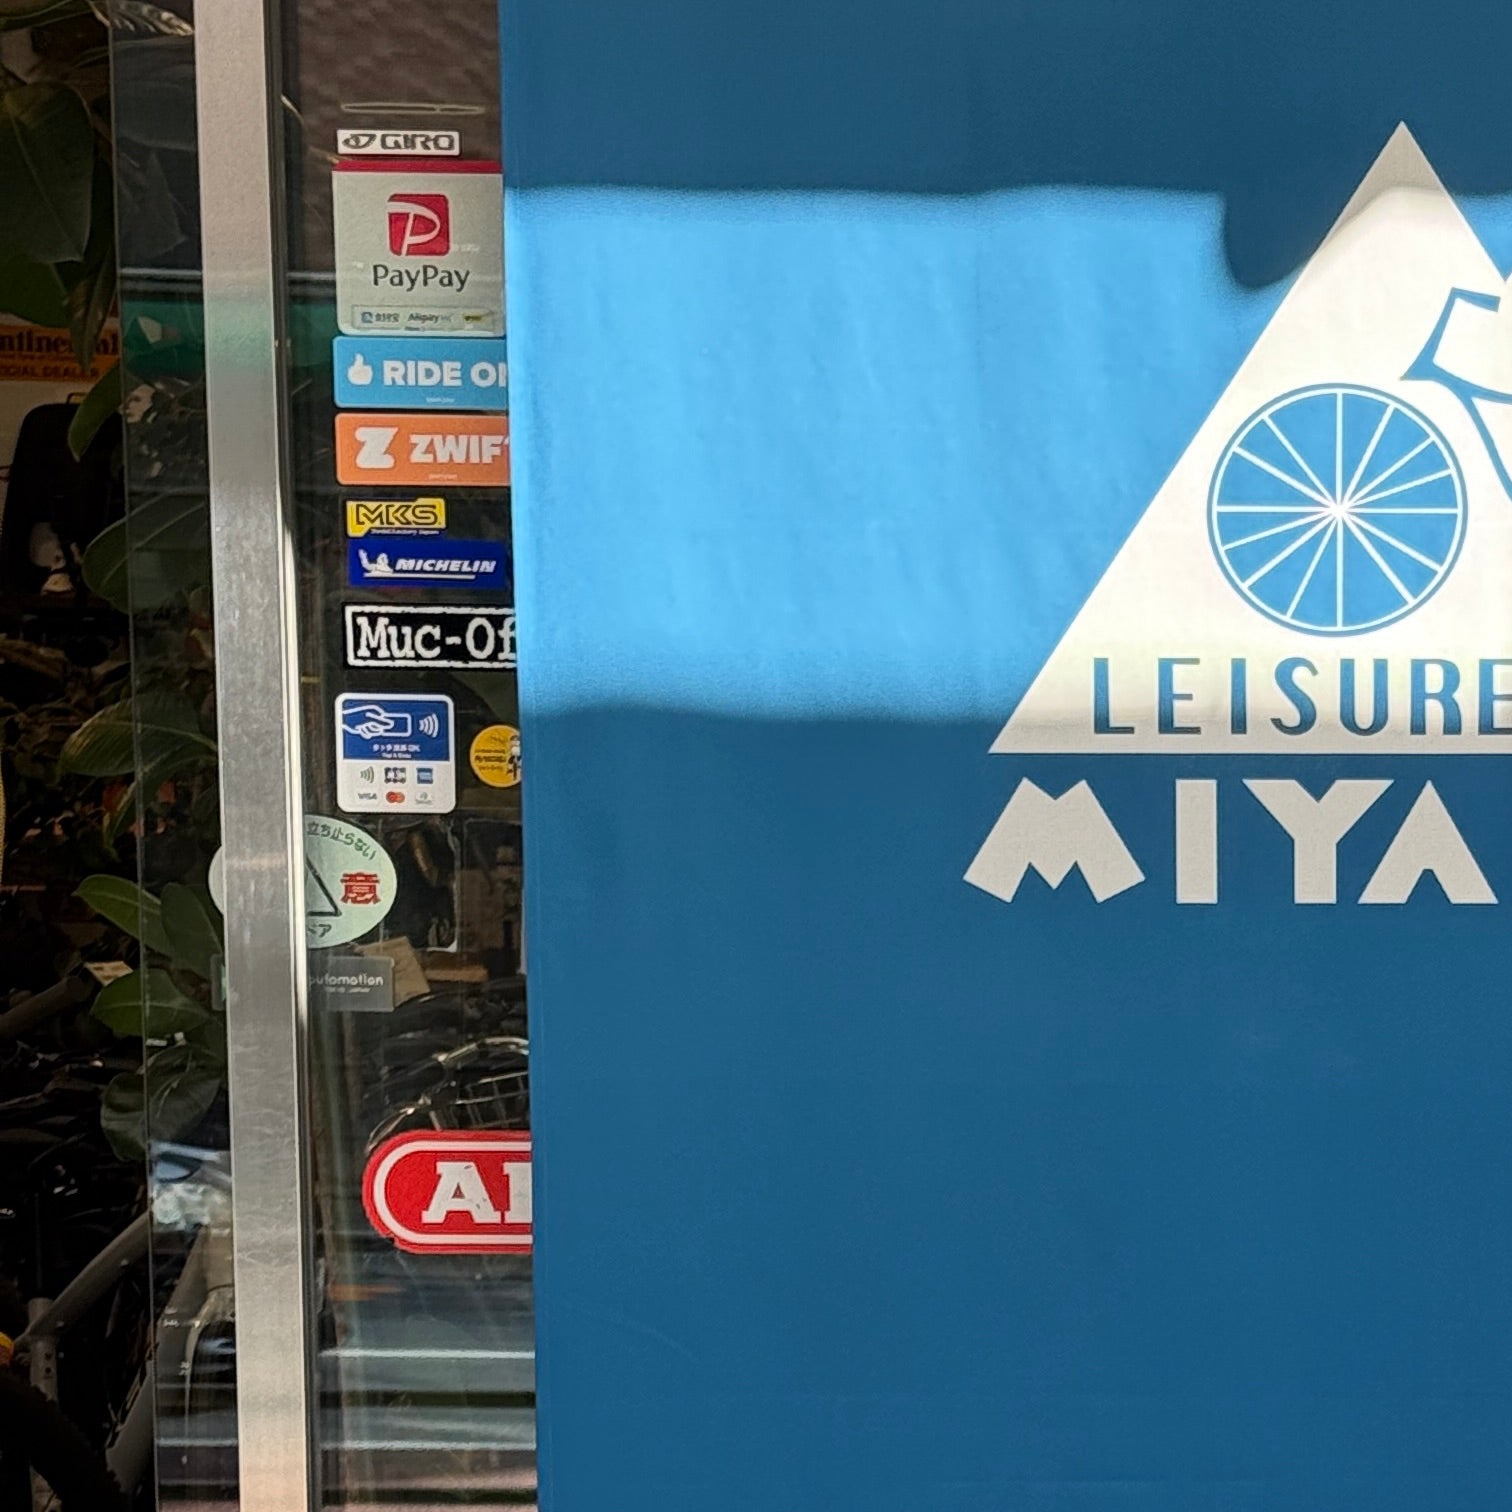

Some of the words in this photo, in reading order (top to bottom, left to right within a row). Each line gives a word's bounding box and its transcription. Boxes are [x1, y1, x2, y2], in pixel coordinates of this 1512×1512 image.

[380, 133, 455, 151] GIRO
[372, 264, 470, 292] PayPay
[382, 360, 463, 387] RIDE
[409, 434, 510, 464] ZWIF
[355, 504, 439, 525] MKS
[395, 558, 497, 573] MICHELIN
